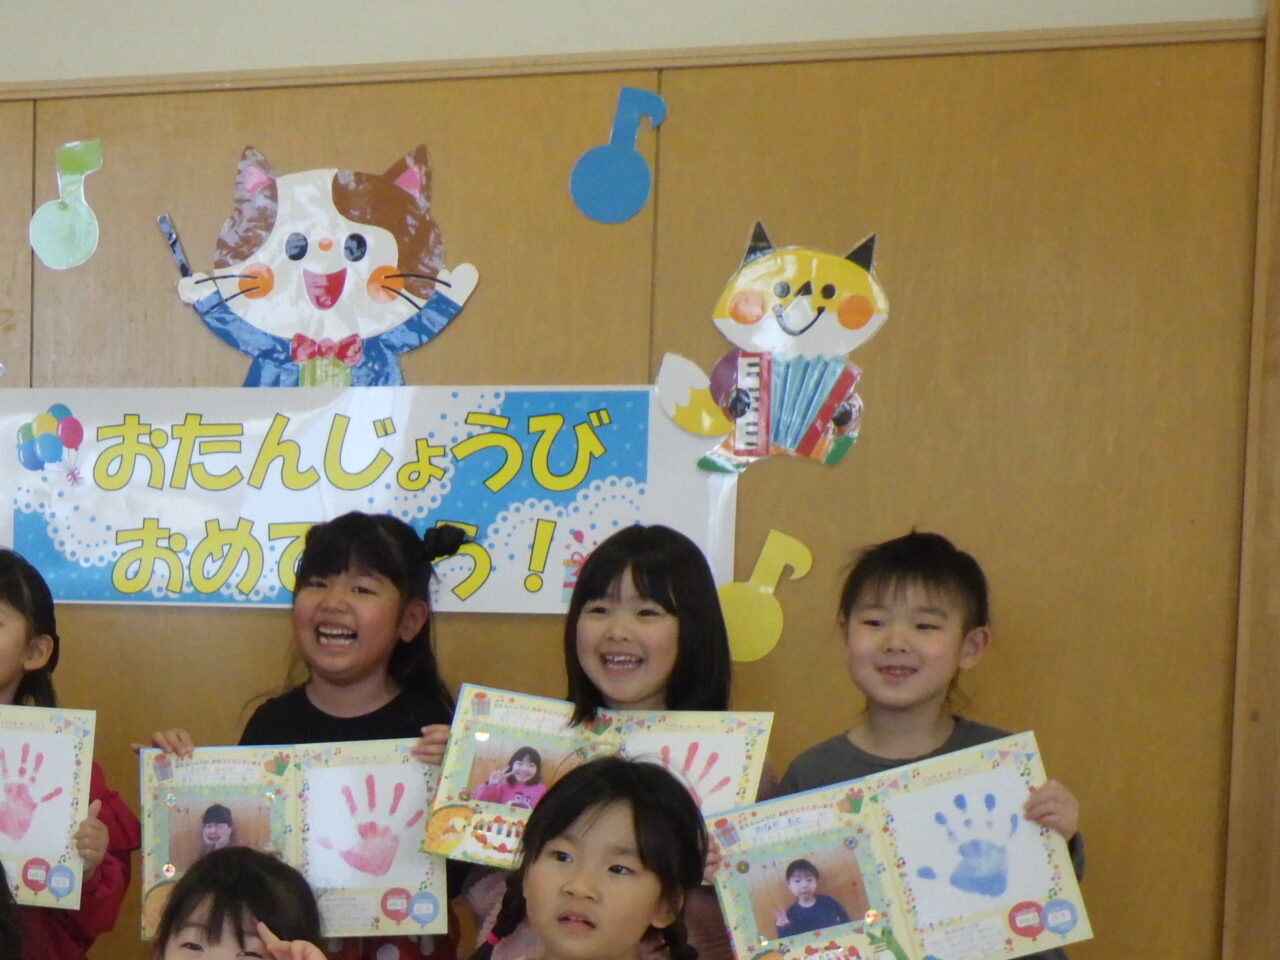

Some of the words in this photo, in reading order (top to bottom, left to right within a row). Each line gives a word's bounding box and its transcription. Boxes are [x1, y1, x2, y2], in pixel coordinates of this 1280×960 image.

[92, 408, 613, 493] おたんじょうび
